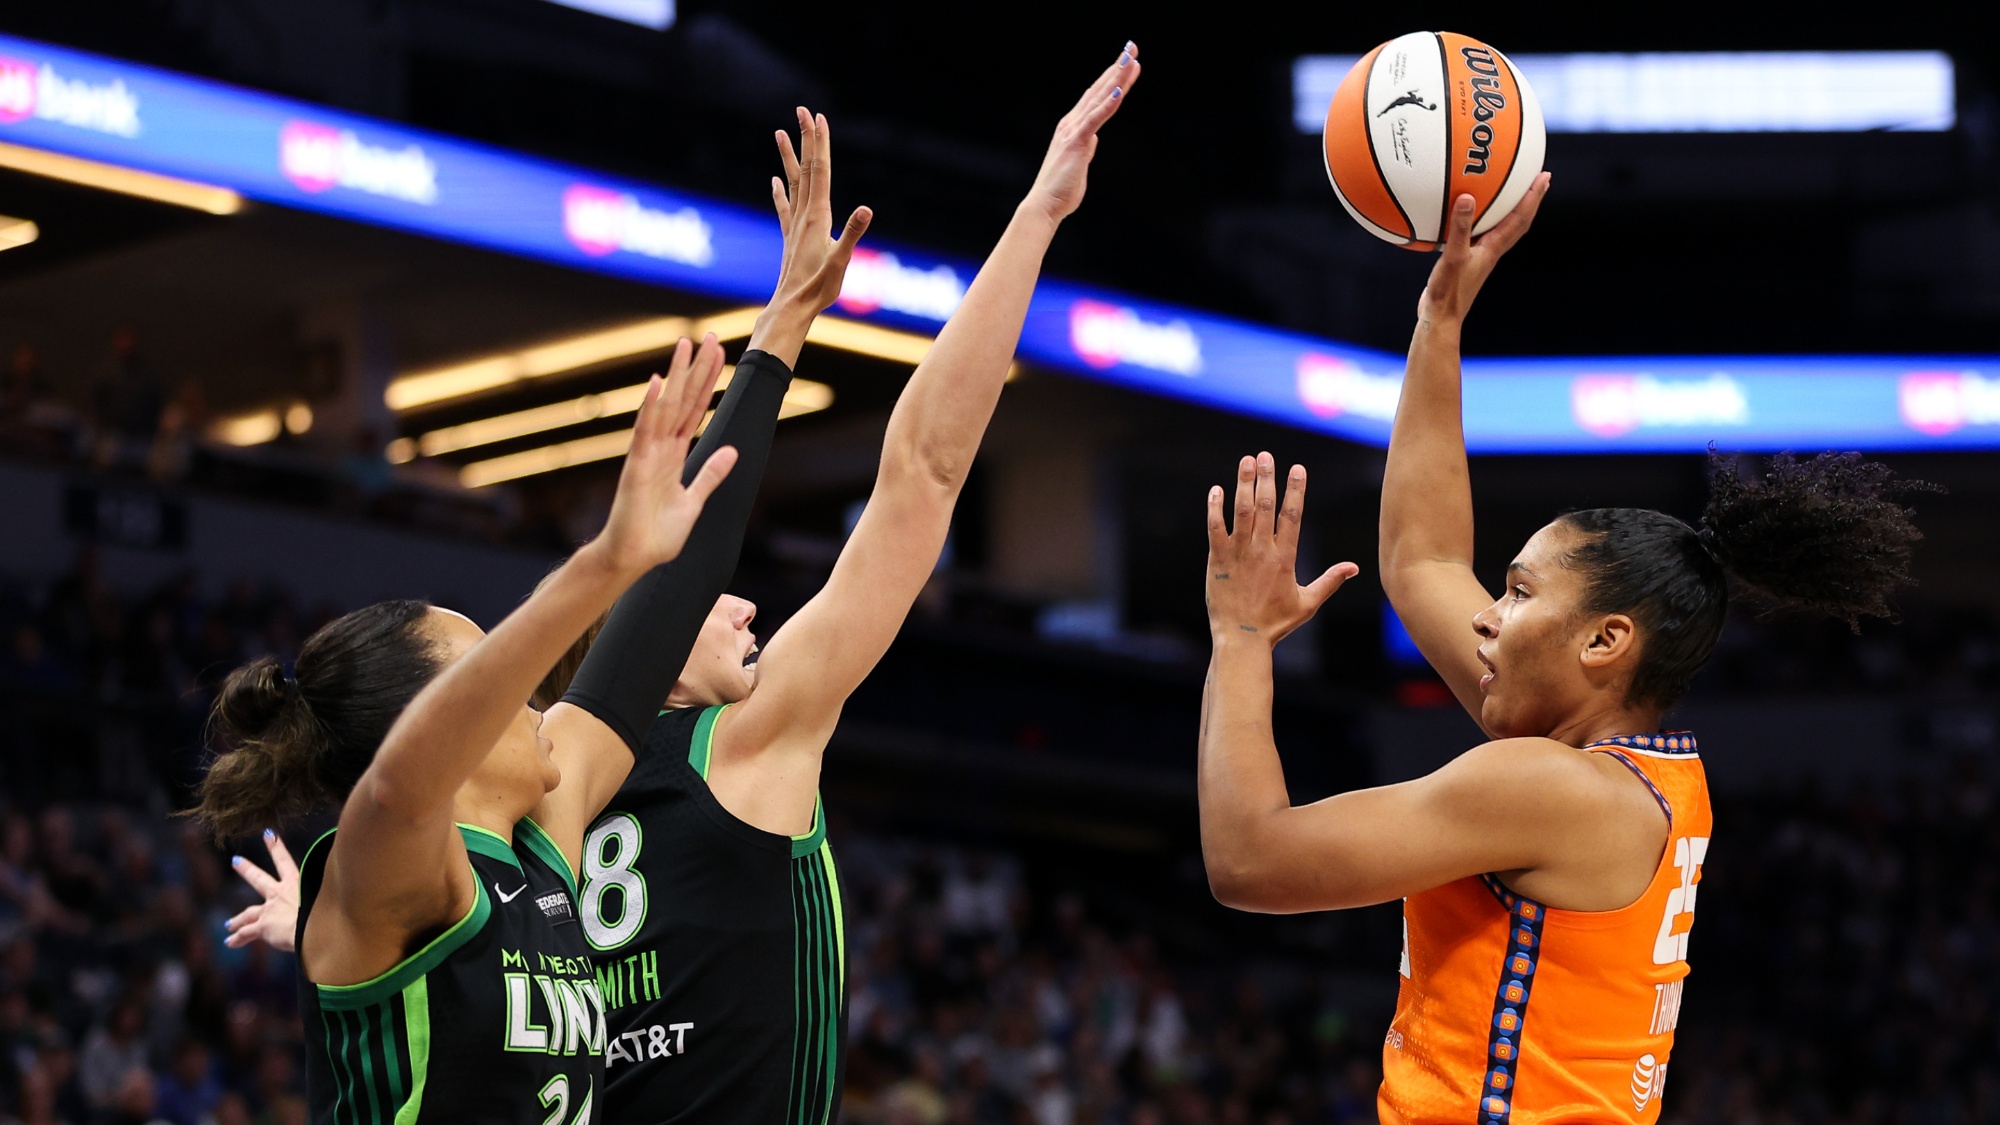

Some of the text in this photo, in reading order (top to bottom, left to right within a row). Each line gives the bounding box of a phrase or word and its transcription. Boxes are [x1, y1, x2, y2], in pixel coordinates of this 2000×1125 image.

[1461, 46, 1505, 176] Wilson
[579, 811, 648, 951] 8
[596, 951, 661, 1012] MITH
[605, 1021, 694, 1068] AT&T
